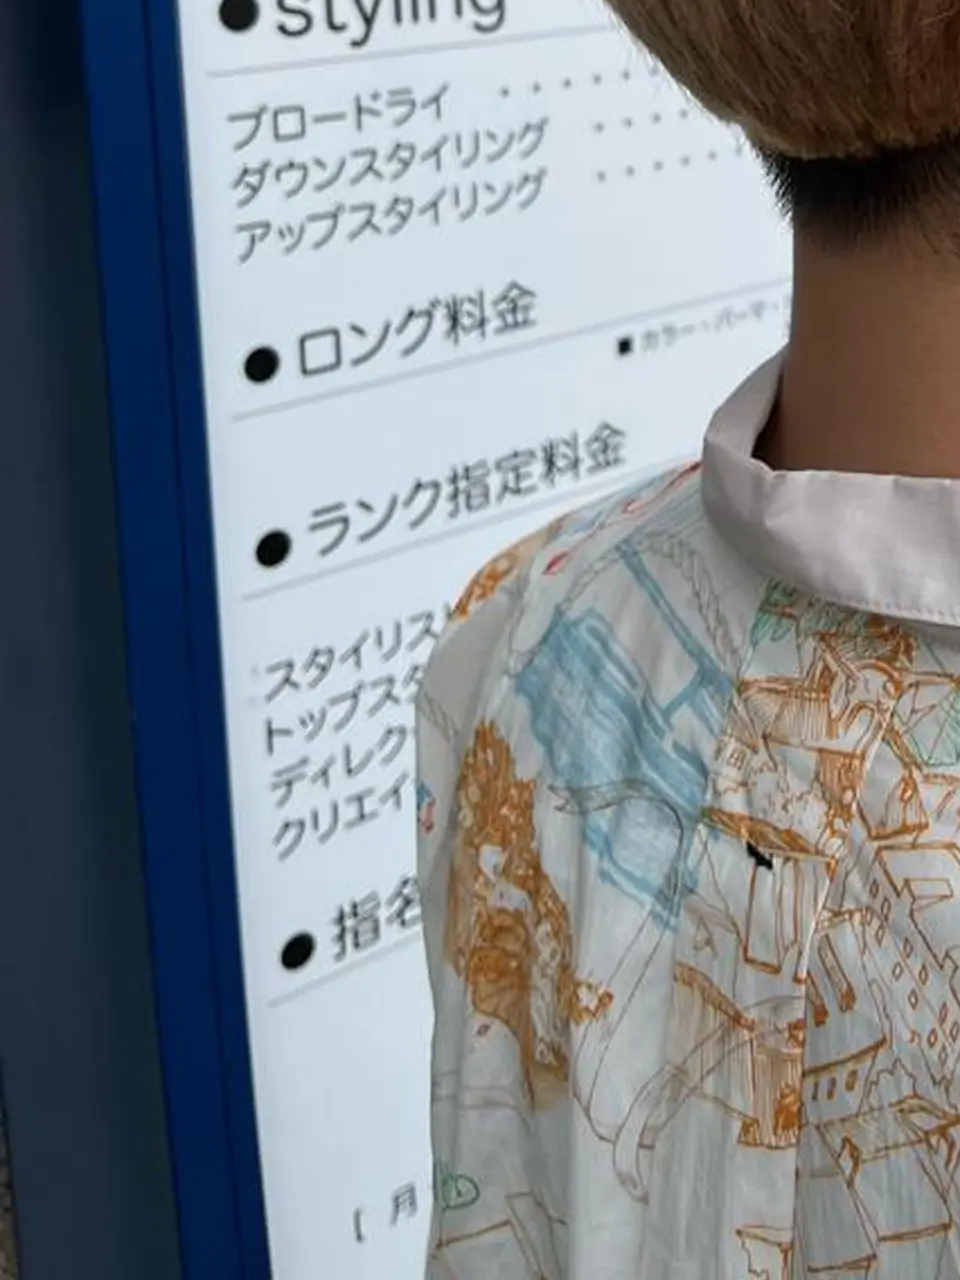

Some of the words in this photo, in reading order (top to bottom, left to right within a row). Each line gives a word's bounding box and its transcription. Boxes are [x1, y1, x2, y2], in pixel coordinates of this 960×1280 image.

[226, 83, 451, 153] ブロードライ
[231, 116, 550, 209] ダウンスタイリング
[235, 167, 549, 265] アップスタイリング
[298, 280, 538, 377] ロング料金
[308, 420, 629, 557] ランク指定料金
[273, 770, 409, 862] クリエイ
